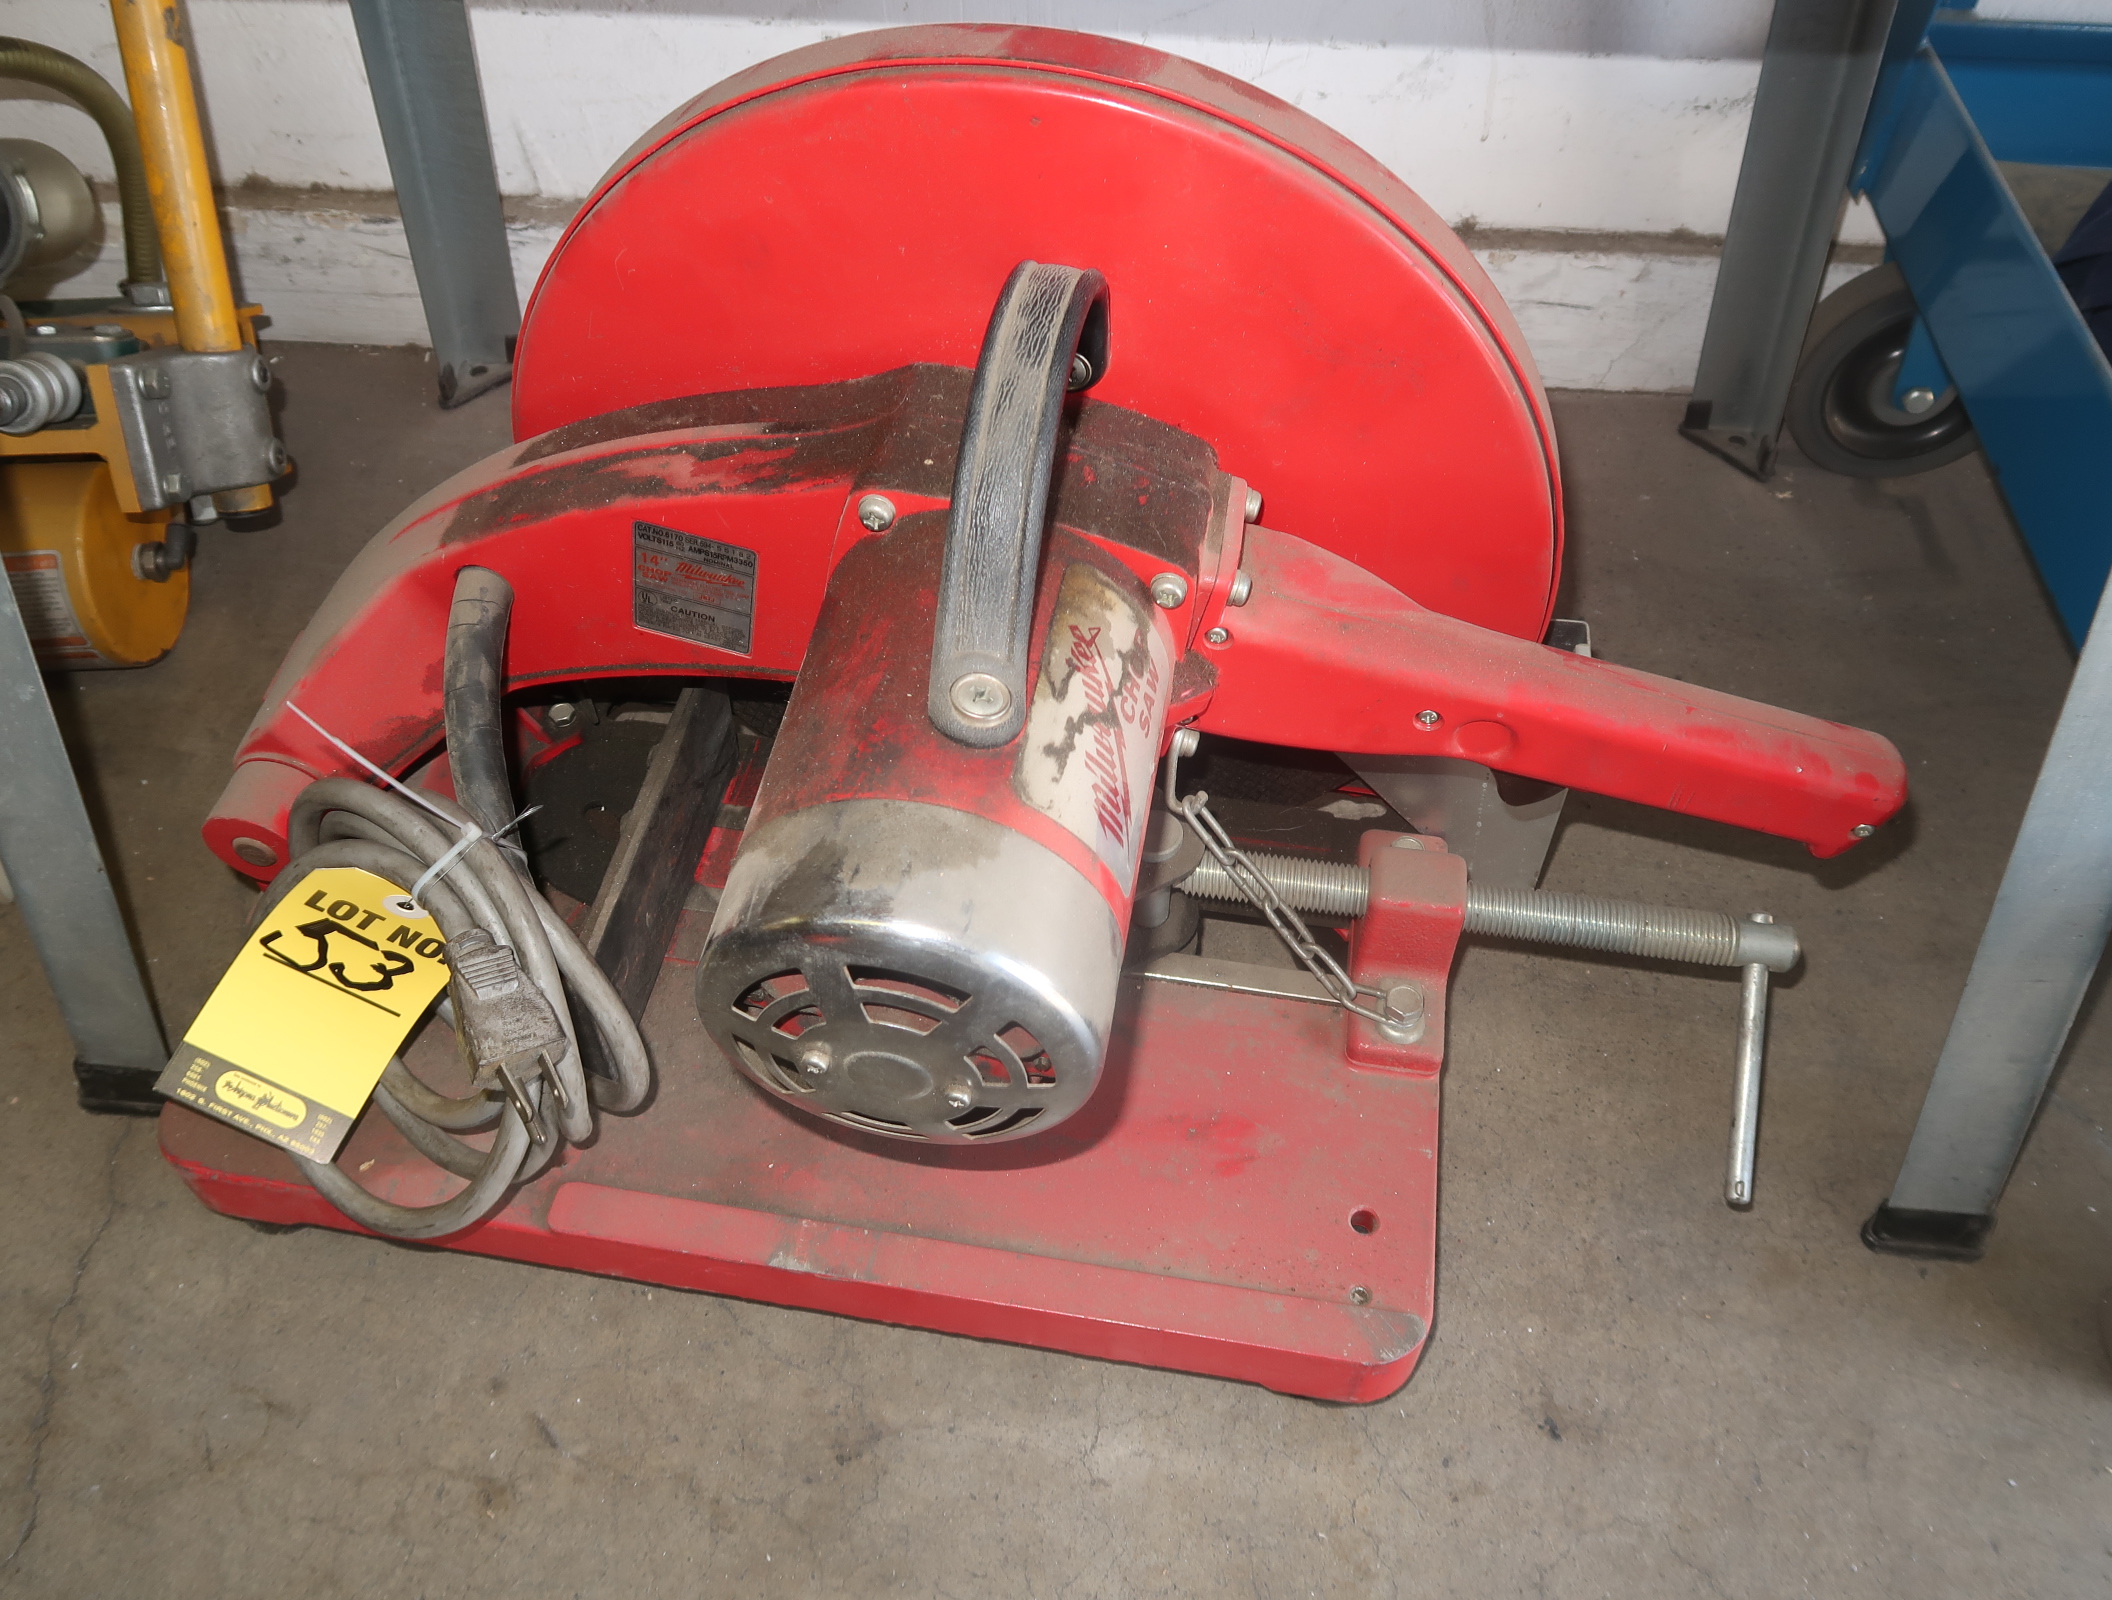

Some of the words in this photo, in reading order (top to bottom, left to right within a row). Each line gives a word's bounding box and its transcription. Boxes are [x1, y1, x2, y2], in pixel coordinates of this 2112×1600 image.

[637, 564, 672, 576] CHOP
[703, 557, 734, 569] NOMINAL
[641, 571, 668, 582] SAW
[675, 561, 746, 587] Milwaukee
[670, 605, 715, 622] CAUTION
[1139, 658, 1160, 739] SAW
[304, 889, 387, 931] LOT
[259, 917, 415, 992] 53
[207, 1101, 232, 1117] FIRST
